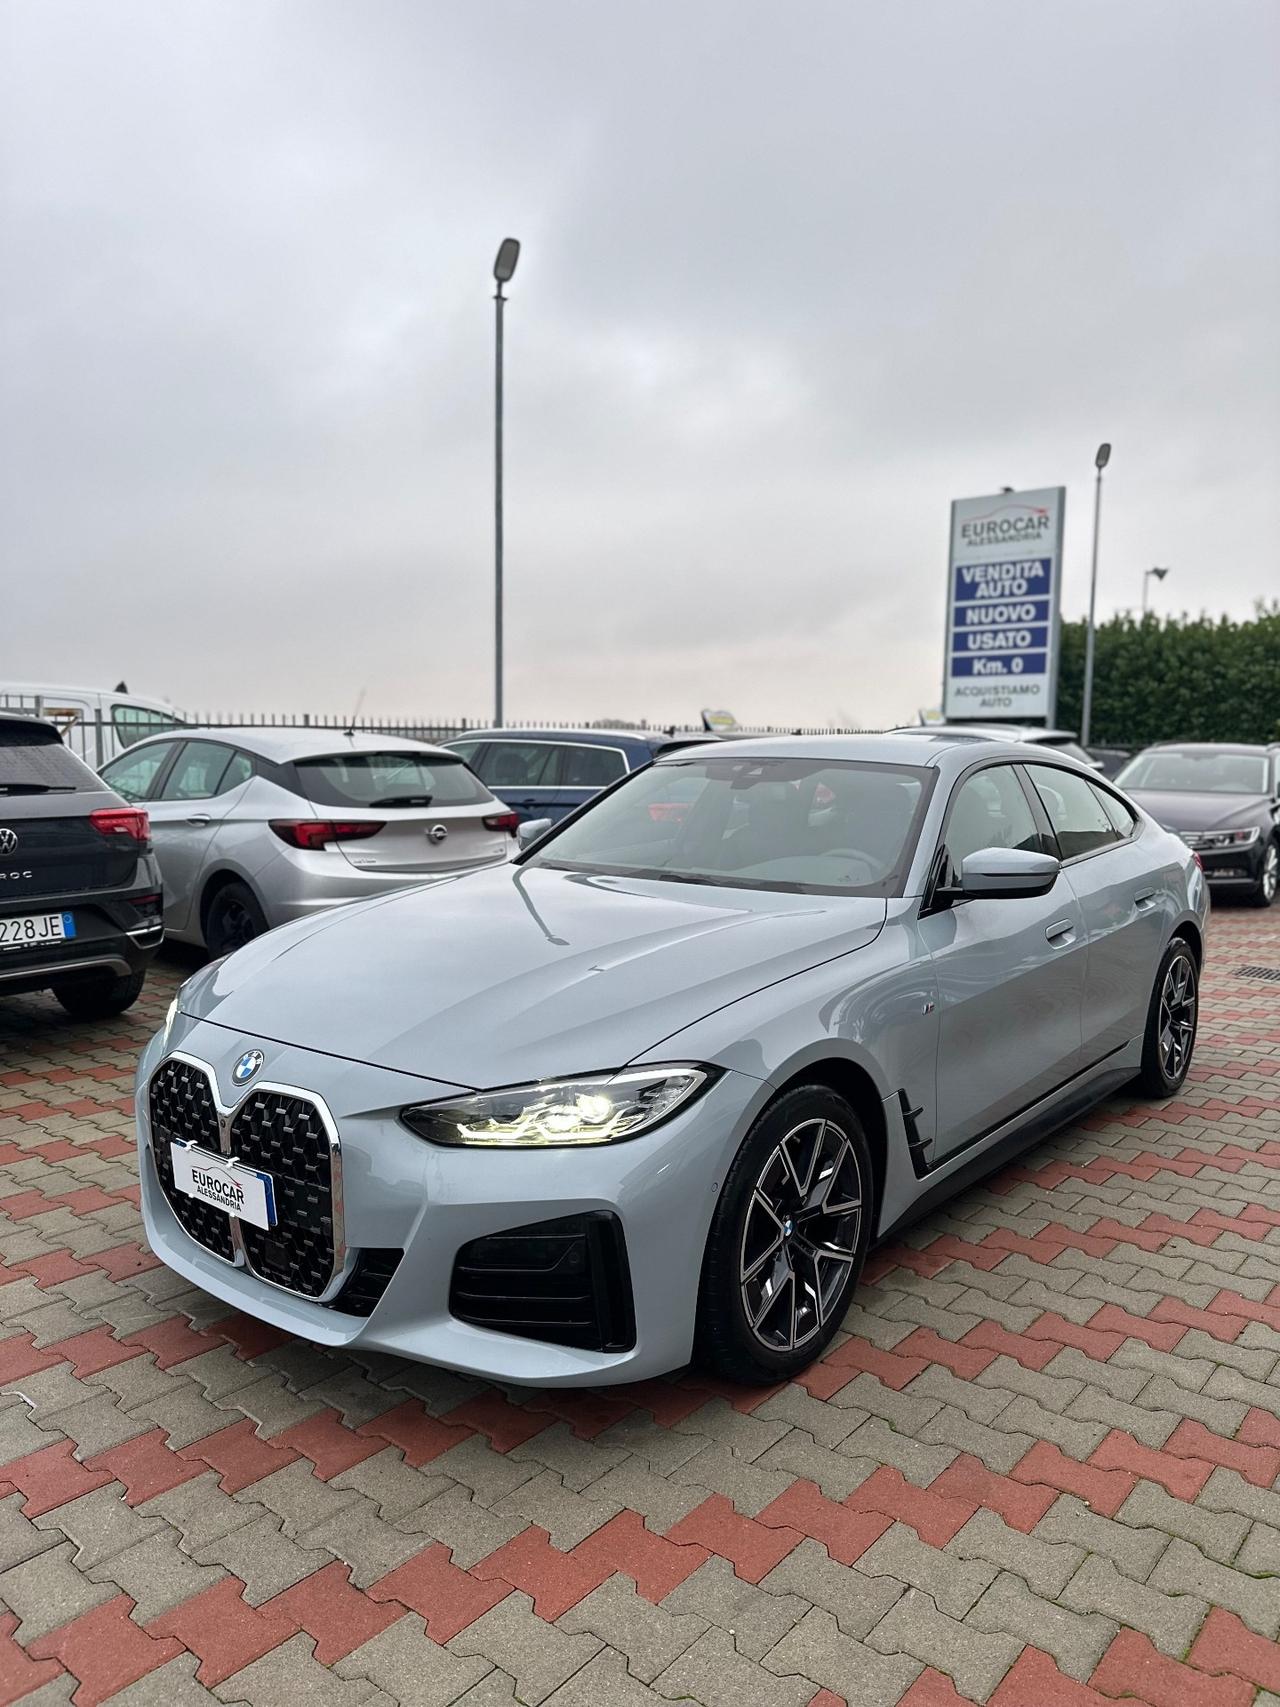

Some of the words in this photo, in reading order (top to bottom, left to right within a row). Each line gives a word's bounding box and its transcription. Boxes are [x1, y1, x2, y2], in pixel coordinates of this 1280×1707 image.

[961, 515, 1049, 539] EUROCAR
[966, 532, 1042, 547] ALESSANDRIA
[962, 561, 1044, 584] VENDITA
[975, 579, 1027, 598] AUTO
[966, 603, 1036, 624] NUOVO
[967, 630, 1031, 649] USATO
[973, 657, 1008, 675] Km.
[1011, 656, 1024, 673] 0
[955, 684, 1040, 697] ACQUISTIAMO
[980, 697, 1012, 707] AUTO
[191, 1168, 244, 1204] EUROCAR
[197, 1186, 241, 1212] ALESSANDRIA
